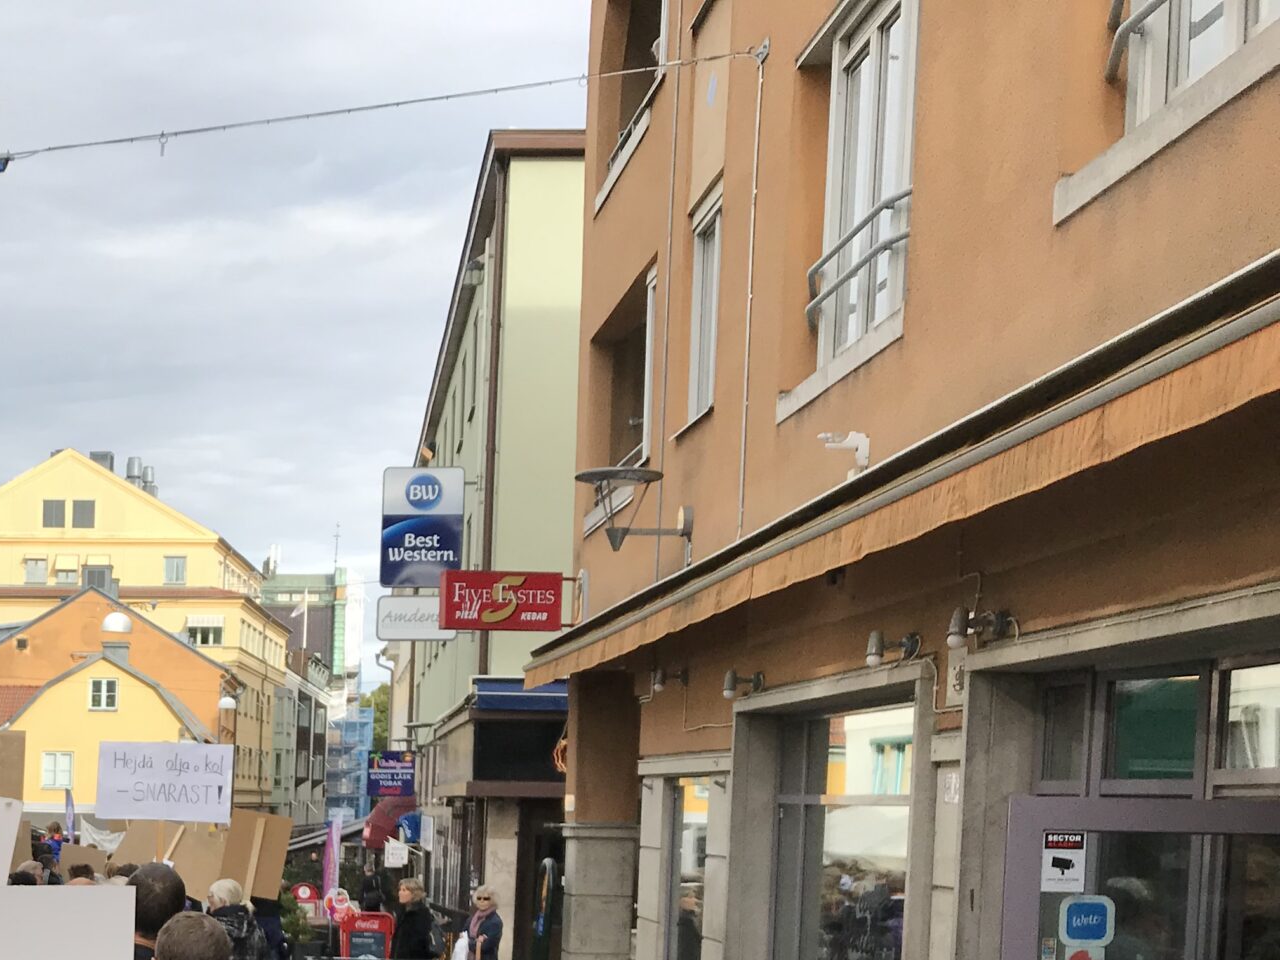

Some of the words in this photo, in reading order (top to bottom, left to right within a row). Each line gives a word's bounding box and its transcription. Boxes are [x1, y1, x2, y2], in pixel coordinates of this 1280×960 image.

[410, 485, 439, 500] BW
[405, 533, 440, 547] Best
[453, 582, 491, 603] FIVE
[494, 583, 555, 604] TASTES
[455, 610, 478, 620] PIZZA
[520, 612, 548, 621] KEBAB
